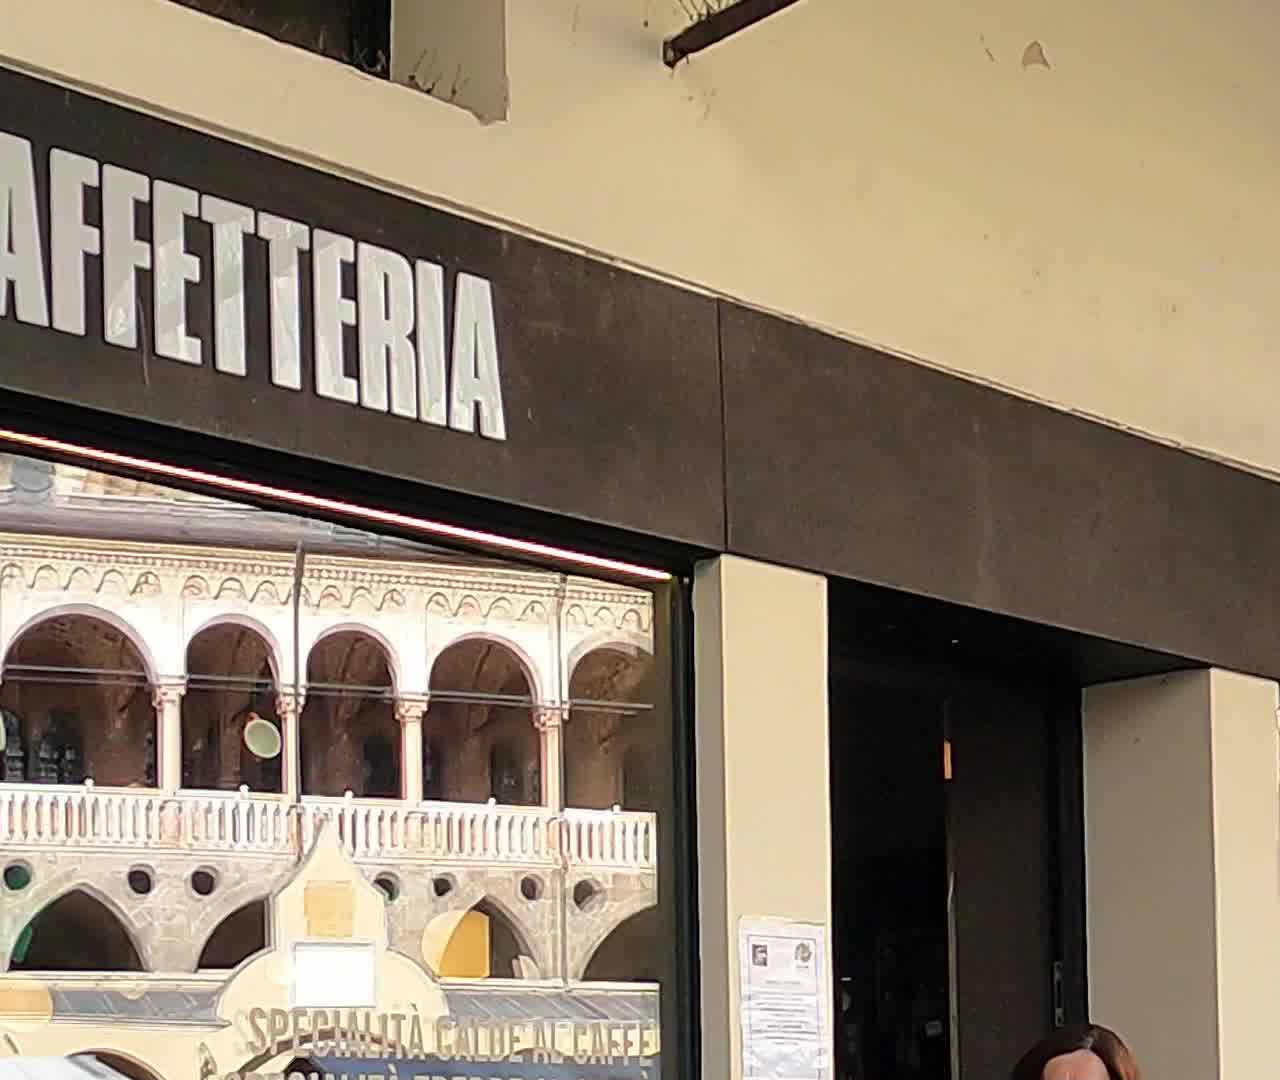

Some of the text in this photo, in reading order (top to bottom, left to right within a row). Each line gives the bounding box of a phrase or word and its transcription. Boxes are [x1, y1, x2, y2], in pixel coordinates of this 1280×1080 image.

[246, 1002, 424, 1061] SPECIALITÀ
[436, 1016, 525, 1063] CALDE
[534, 1020, 566, 1064] AL
